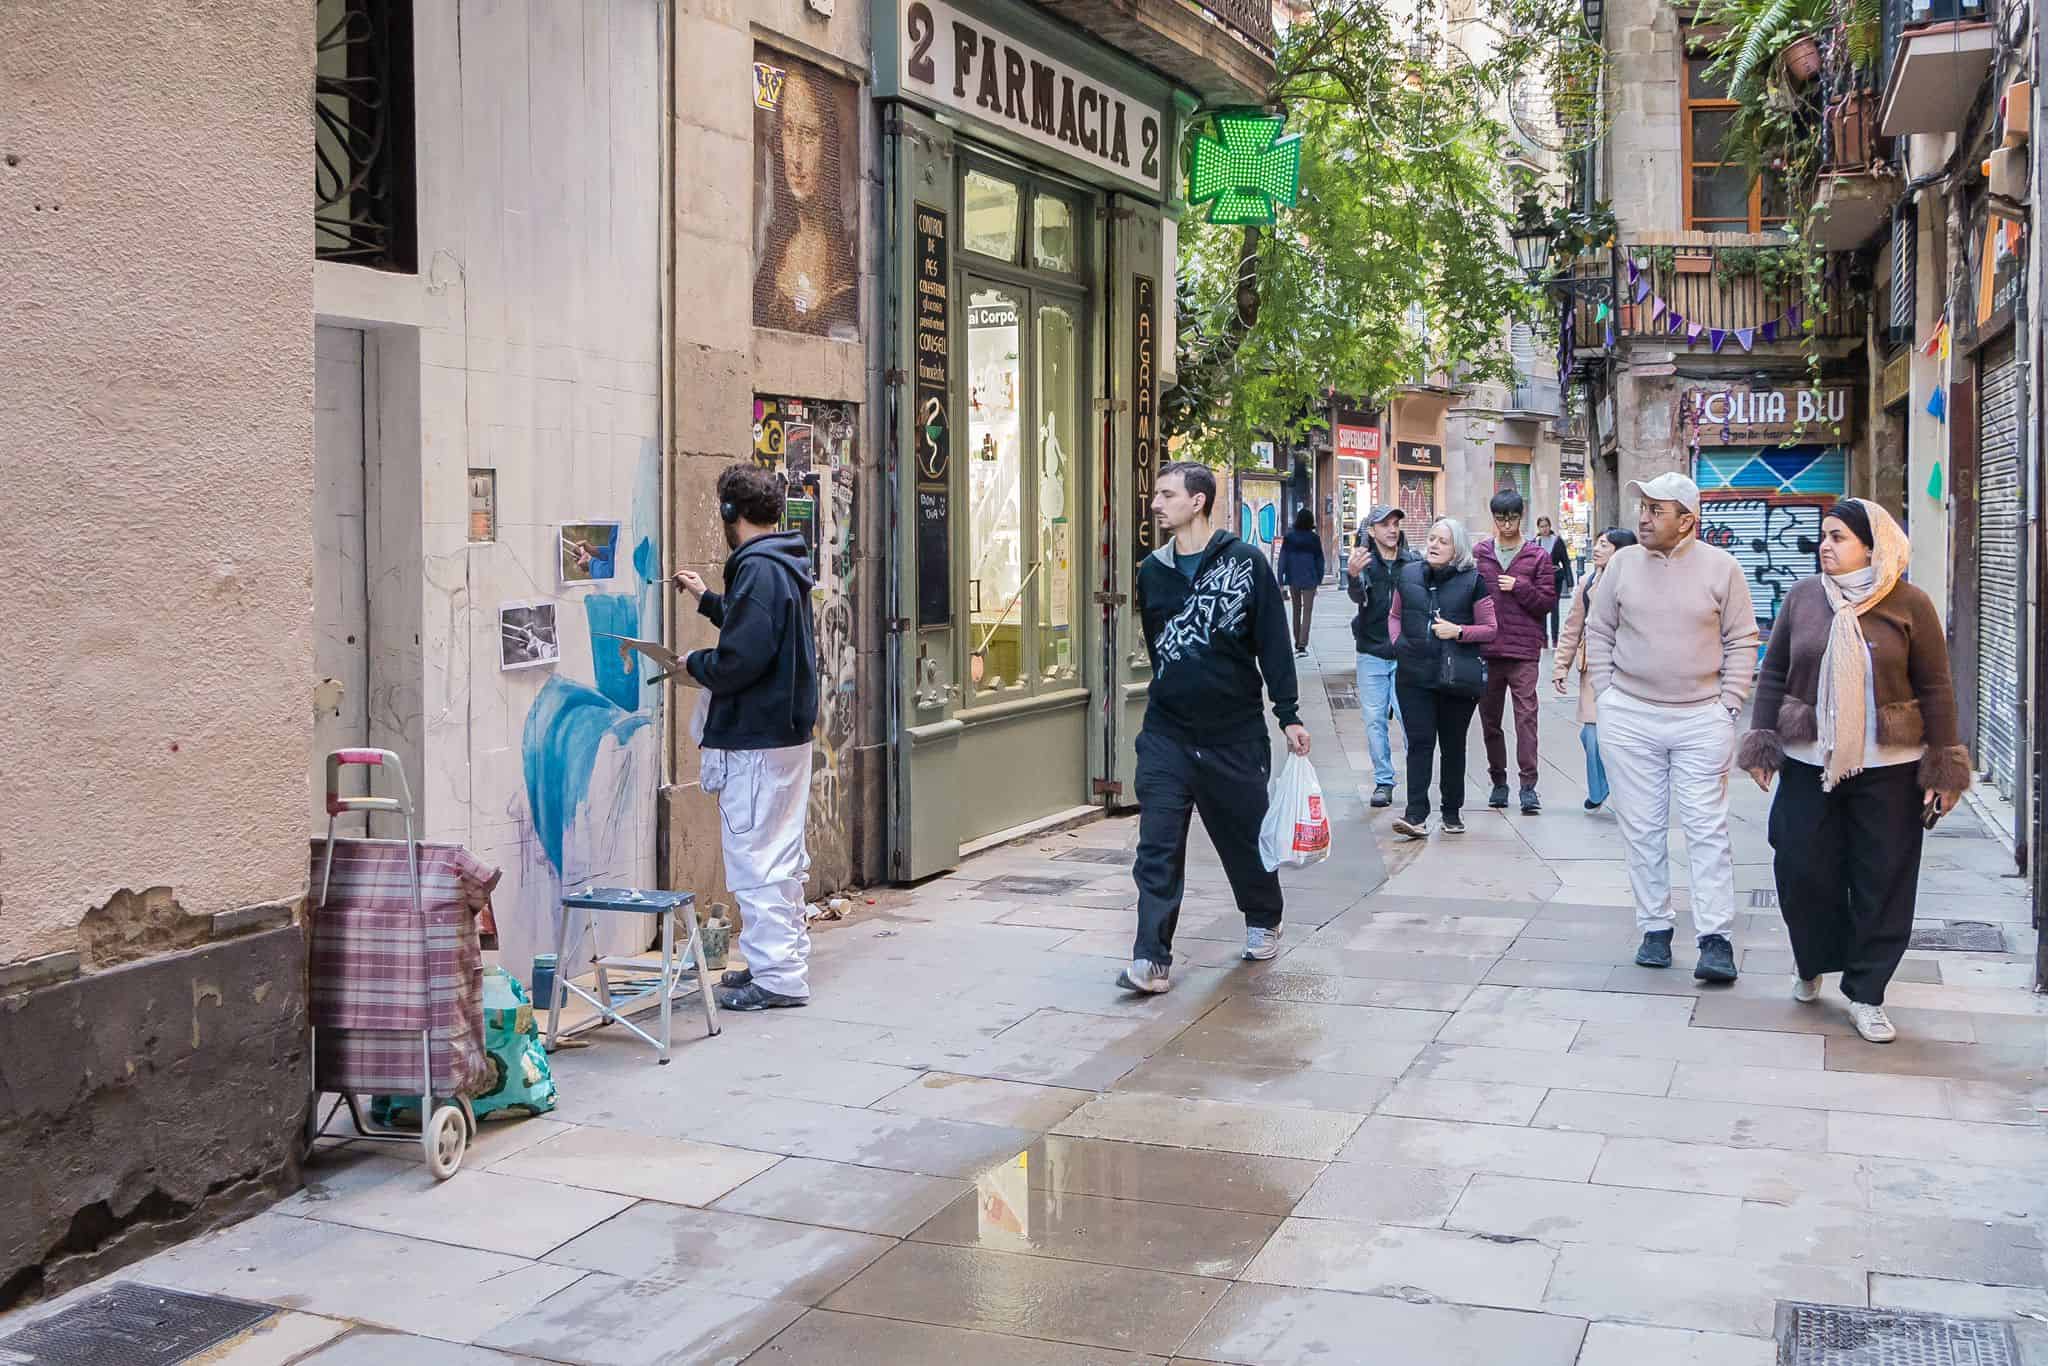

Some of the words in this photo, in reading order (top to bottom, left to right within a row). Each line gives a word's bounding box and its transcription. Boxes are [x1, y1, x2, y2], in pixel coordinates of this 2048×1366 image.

[907, 2, 935, 84] 2
[952, 20, 1130, 168] FARMACIA
[1141, 116, 1159, 179] 2
[918, 214, 944, 238] CONTROL
[980, 310, 1018, 326] Corpo
